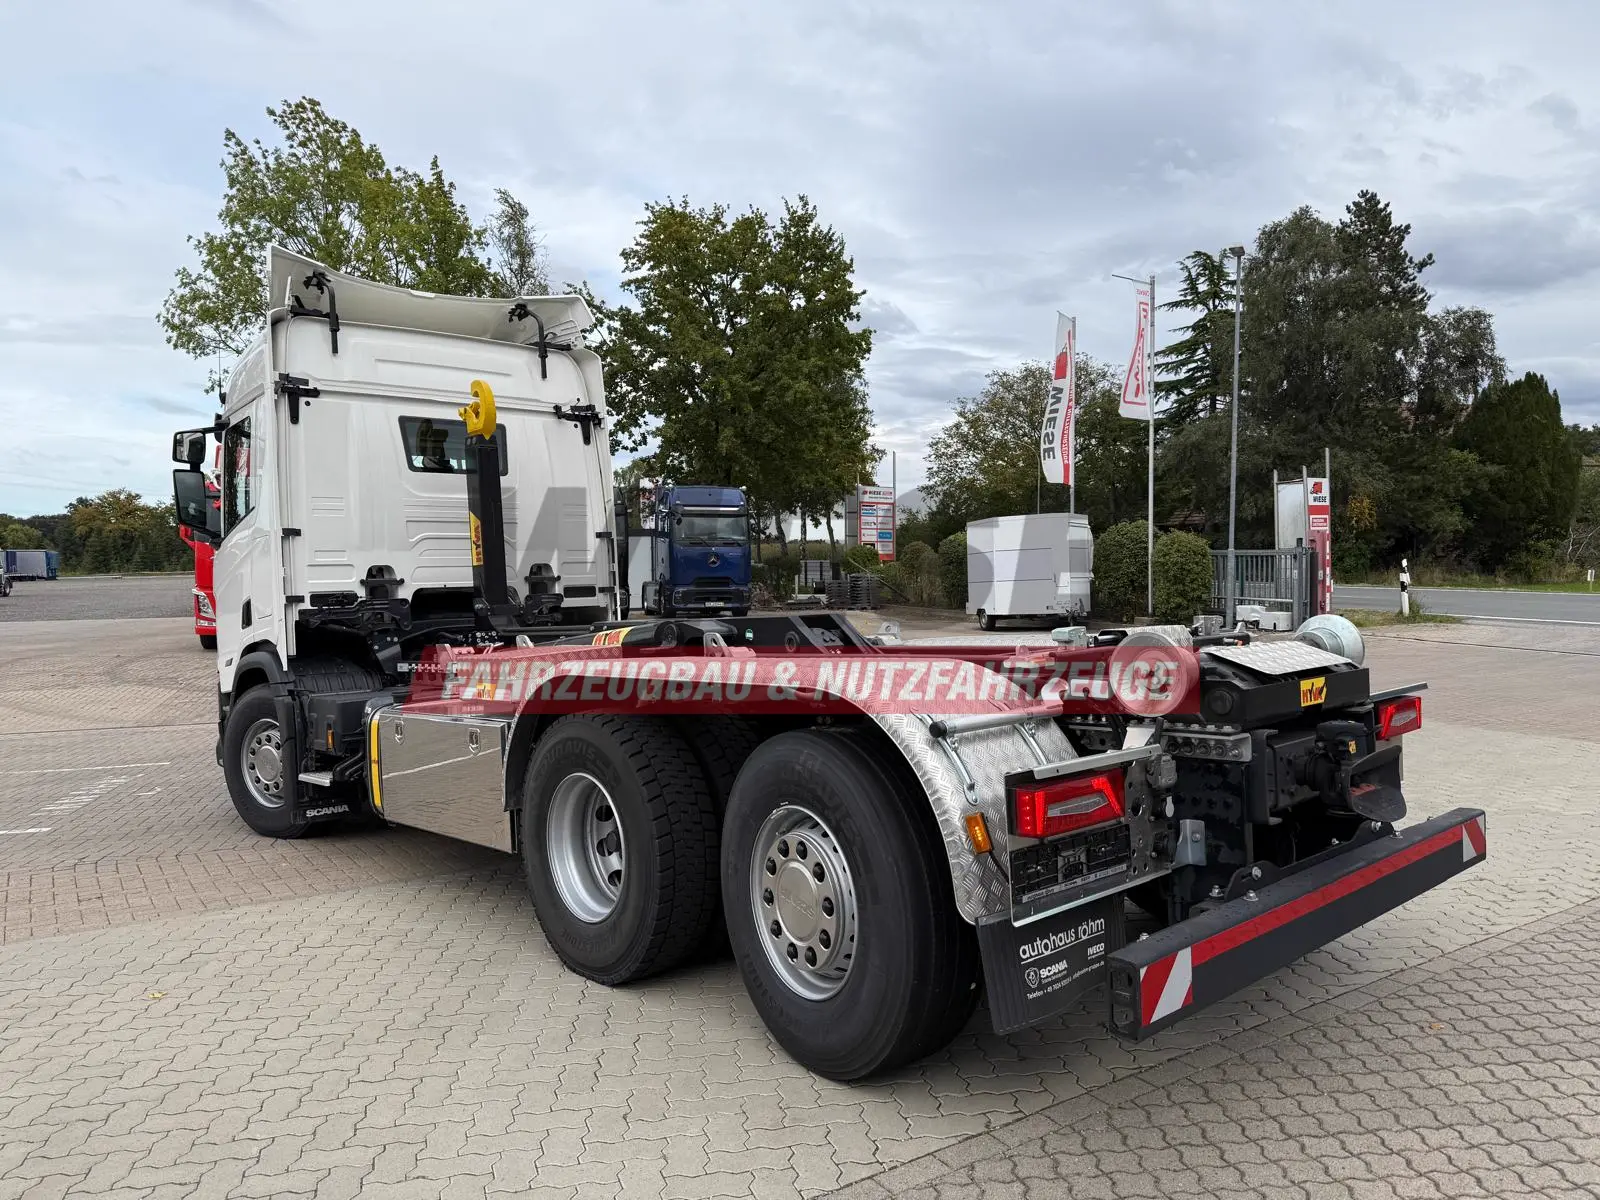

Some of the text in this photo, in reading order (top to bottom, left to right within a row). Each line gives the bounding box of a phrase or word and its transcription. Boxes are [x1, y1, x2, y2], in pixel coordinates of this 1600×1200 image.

[1312, 495, 1328, 503] WIESE
[1302, 682, 1327, 704] HYVA
[306, 804, 350, 817] SCANIA
[1019, 917, 1105, 959] autohaus röhm
[1087, 942, 1105, 956] IVECO
[1040, 959, 1068, 978] SCANIA
[1026, 989, 1044, 1000] Telefon
